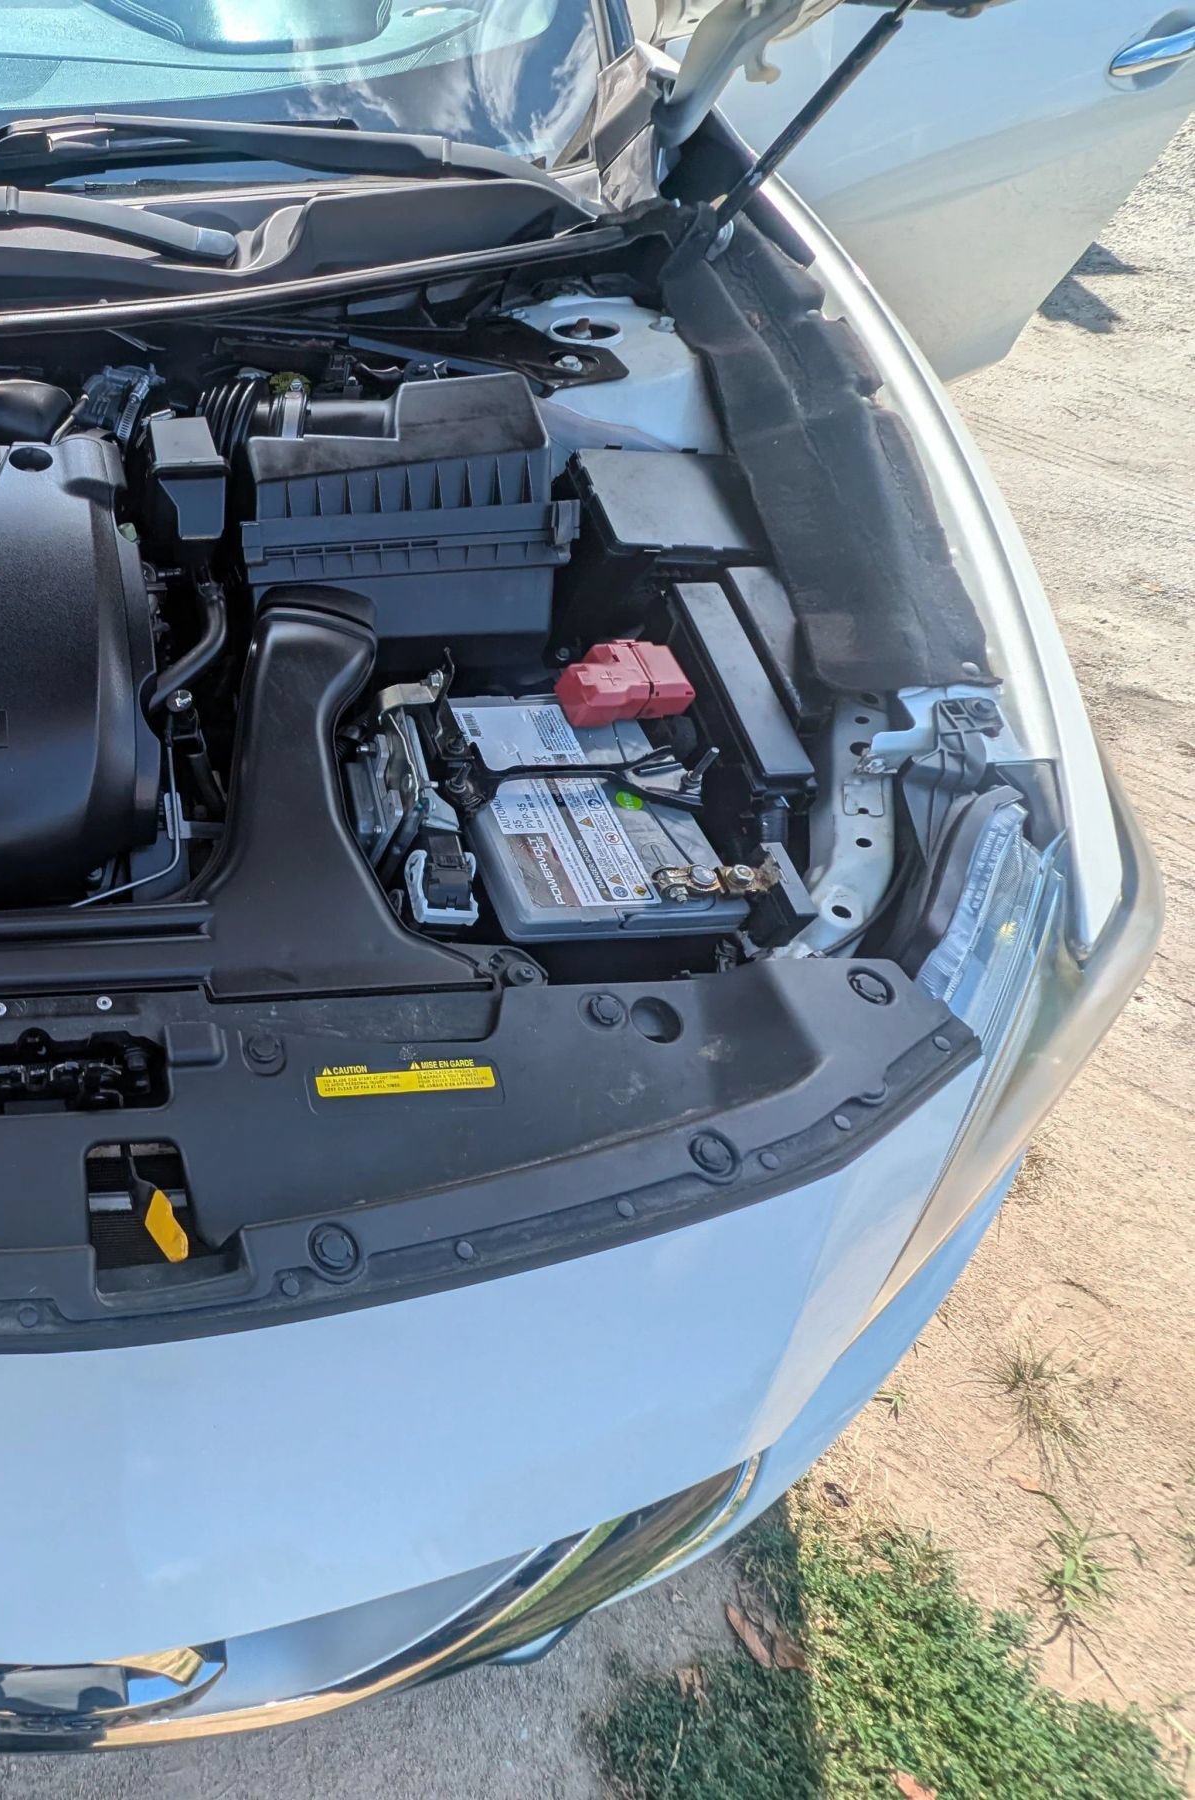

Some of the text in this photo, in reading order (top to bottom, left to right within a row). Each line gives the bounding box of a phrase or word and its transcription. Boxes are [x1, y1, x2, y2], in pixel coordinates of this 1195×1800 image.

[517, 803, 537, 829] PVP-35
[513, 819, 525, 830] 35
[536, 836, 549, 852] PLUS
[527, 836, 566, 906] POWERVOLT
[333, 1065, 368, 1075] CAUTION
[420, 1061, 438, 1069] MISE
[450, 1059, 474, 1068] GARDE
